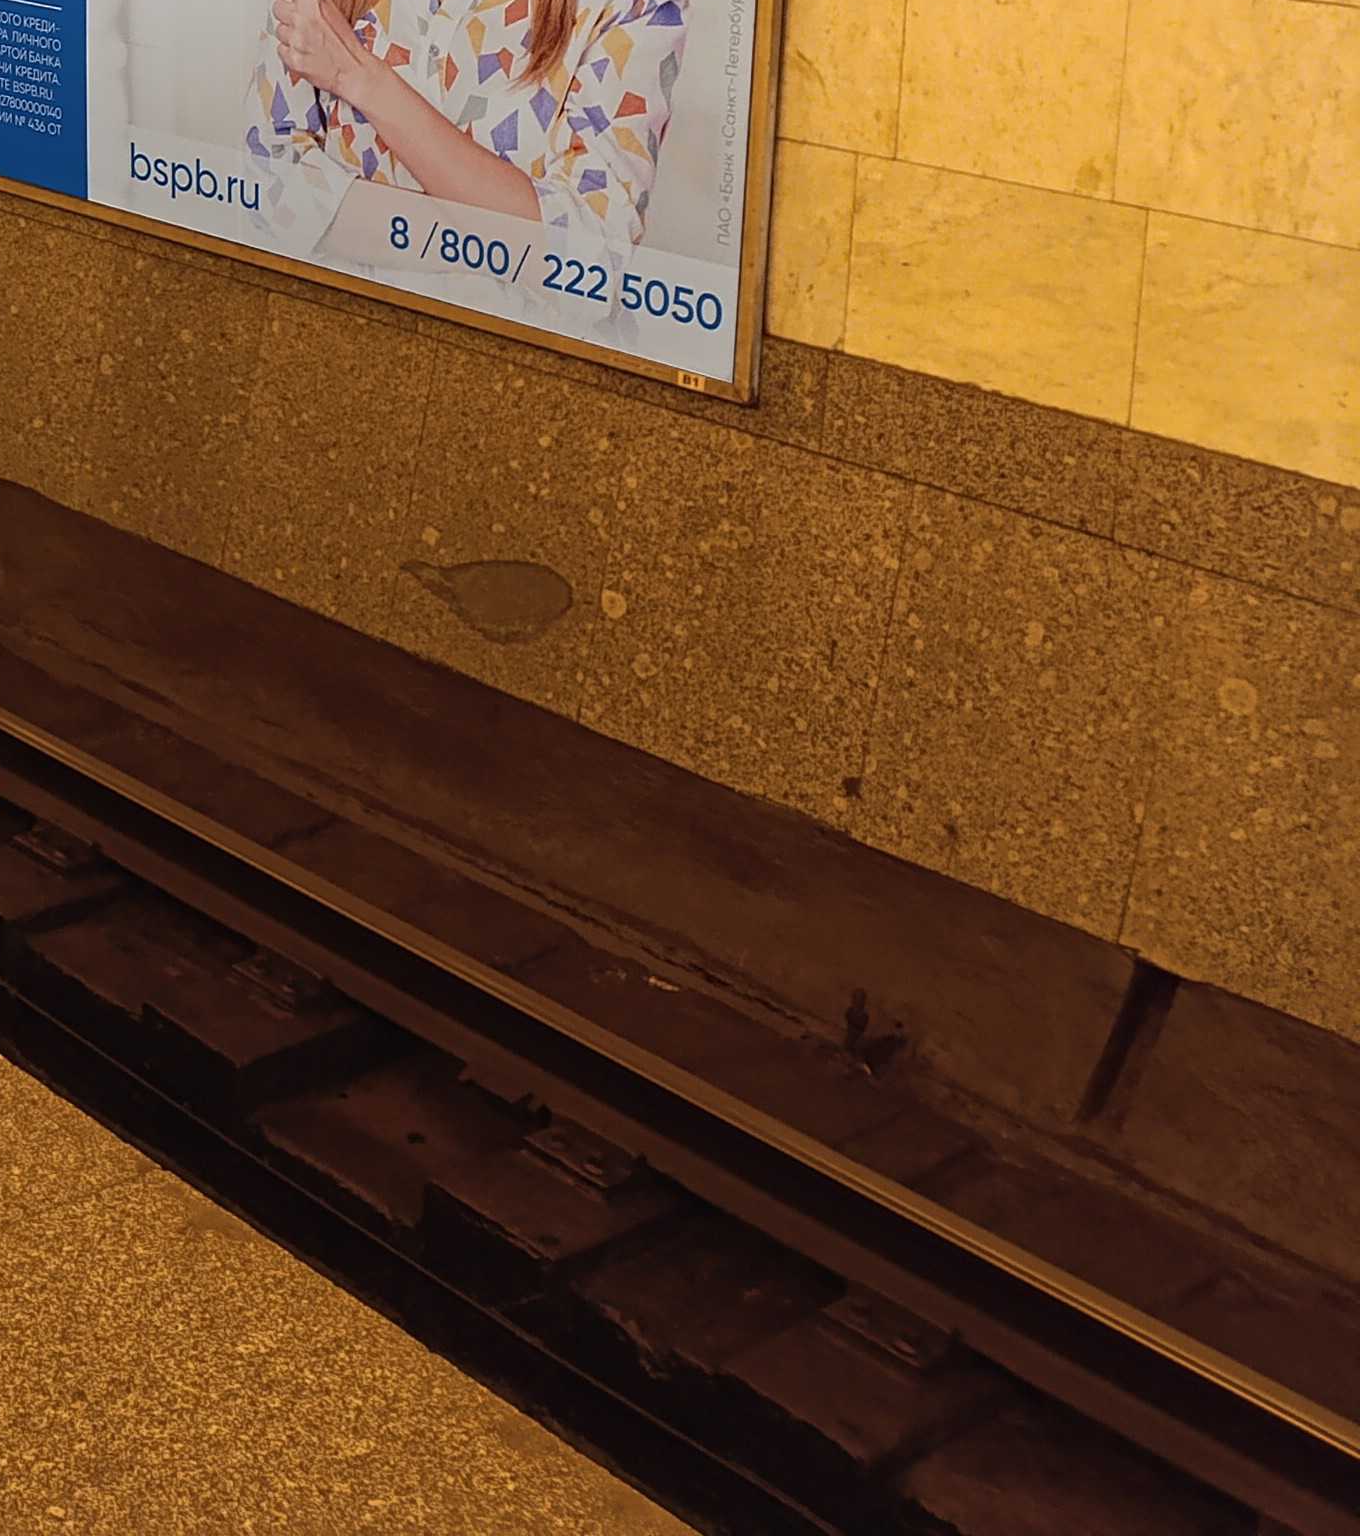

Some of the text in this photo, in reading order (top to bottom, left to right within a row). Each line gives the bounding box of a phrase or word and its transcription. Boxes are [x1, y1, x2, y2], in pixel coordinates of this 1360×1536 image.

[23, 15, 61, 35] КРЕДИ-
[11, 29, 61, 52] ЛИЧНОГО
[28, 49, 61, 69] БАНКА
[27, 116, 46, 133] 436
[47, 121, 62, 137] ОТ
[129, 142, 261, 211] bspb.ru
[717, 208, 730, 246] ПАО
[389, 216, 410, 251] 8
[542, 253, 608, 304] 222
[620, 272, 724, 331] 5050
